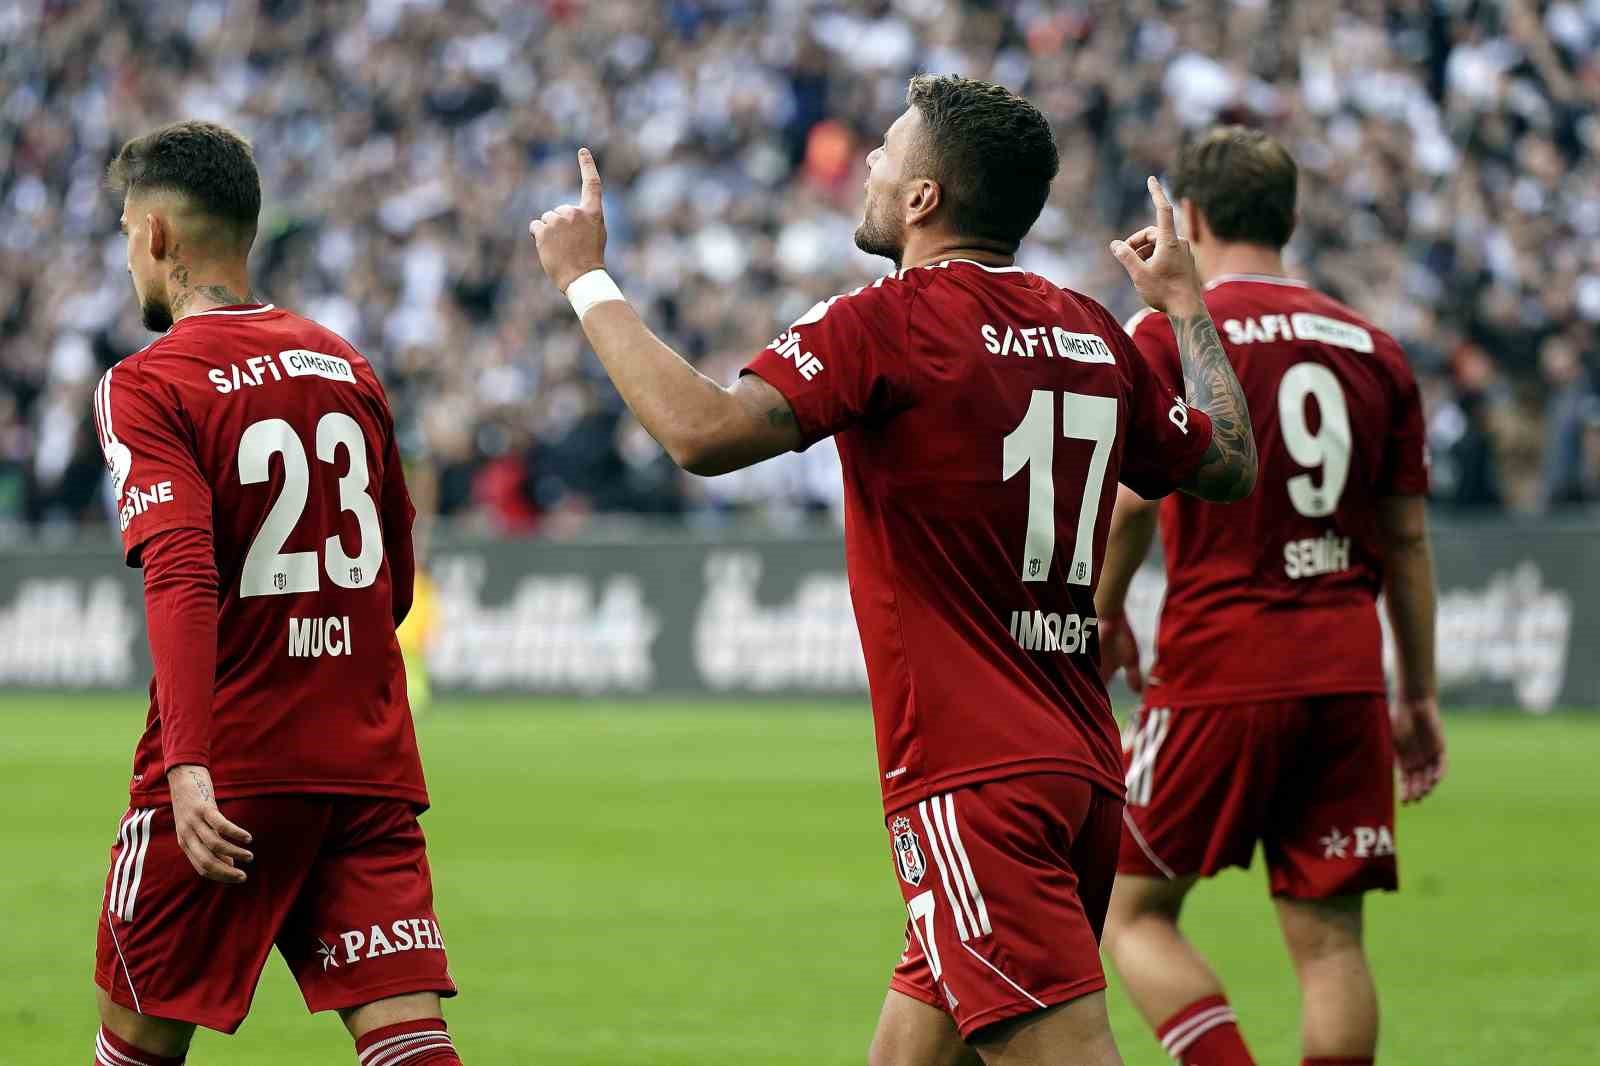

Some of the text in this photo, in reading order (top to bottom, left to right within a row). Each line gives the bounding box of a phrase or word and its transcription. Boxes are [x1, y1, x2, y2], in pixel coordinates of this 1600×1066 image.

[237, 411, 384, 598] 23
[1002, 389, 1118, 586] 17
[1278, 362, 1352, 517] 9
[288, 615, 352, 657] MUCI
